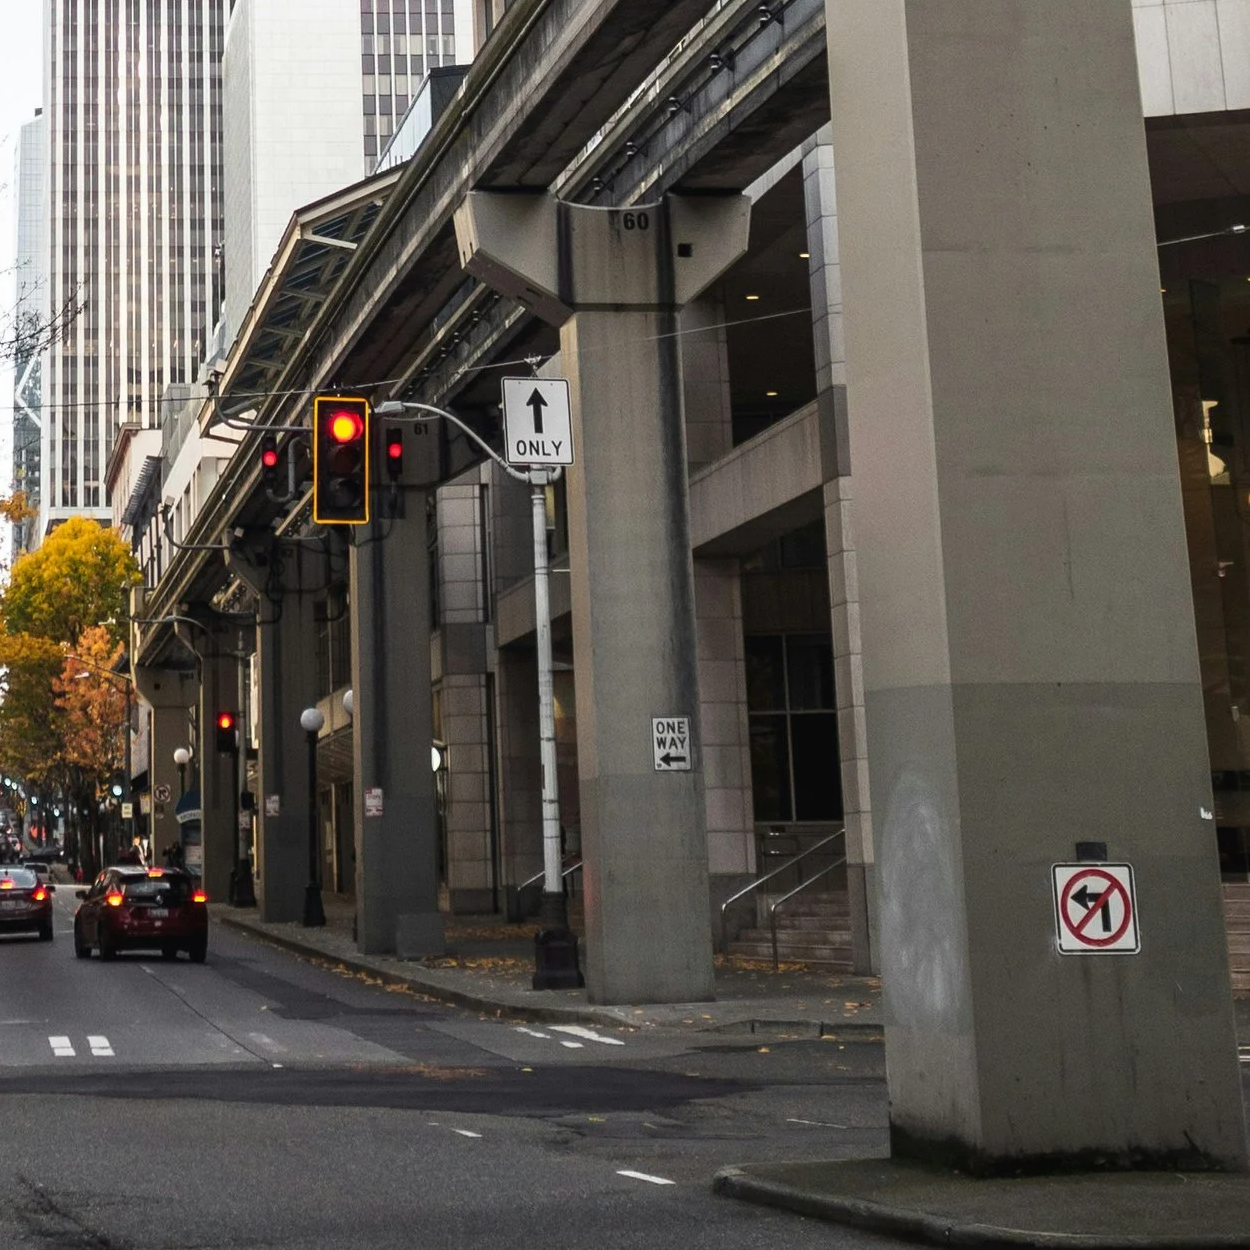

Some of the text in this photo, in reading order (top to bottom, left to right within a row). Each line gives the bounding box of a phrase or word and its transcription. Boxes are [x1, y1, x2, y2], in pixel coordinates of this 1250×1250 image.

[623, 212, 649, 230] 60
[414, 422, 429, 435] 61
[516, 439, 563, 457] ONLY
[656, 721, 686, 735] ONE
[656, 736, 687, 750] WAY
